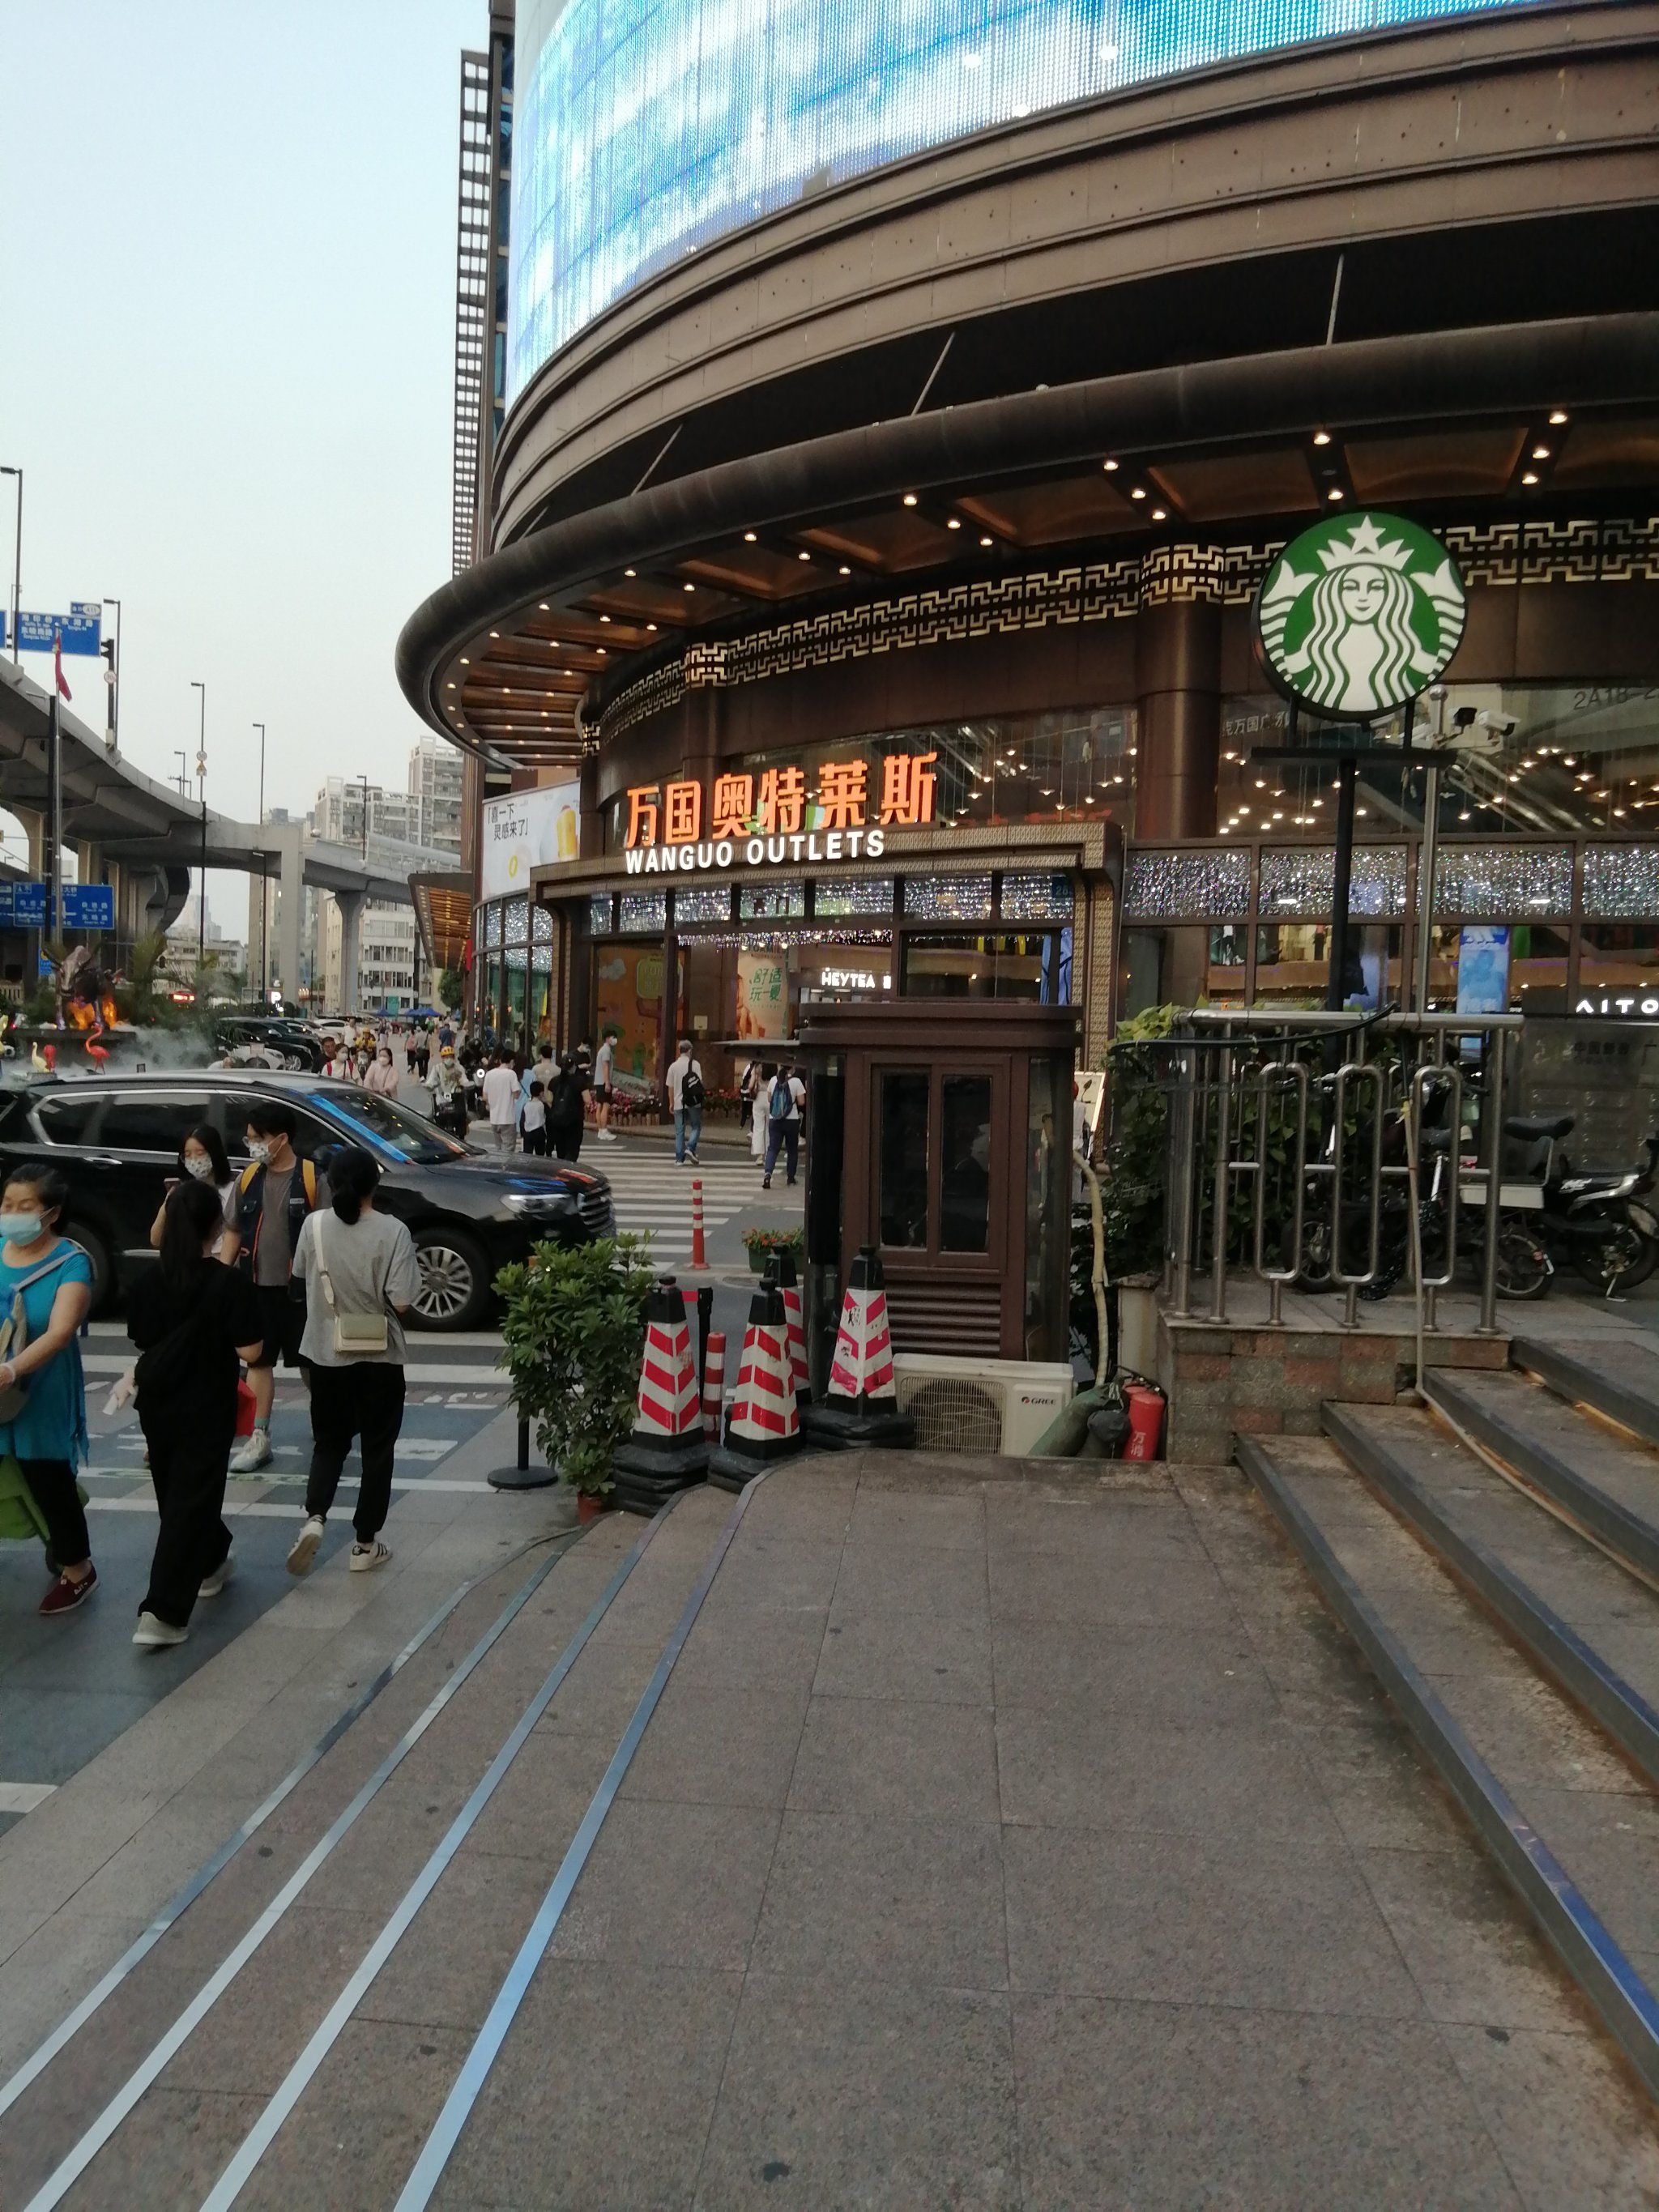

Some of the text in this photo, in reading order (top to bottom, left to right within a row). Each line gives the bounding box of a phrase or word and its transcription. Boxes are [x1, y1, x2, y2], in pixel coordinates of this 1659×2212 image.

[625, 752, 937, 849] 万国奥特莱斯
[625, 830, 885, 875] WANGUO OUTLETS
[821, 971, 876, 989] HEYTEA
[1576, 999, 1659, 1014] AITO
